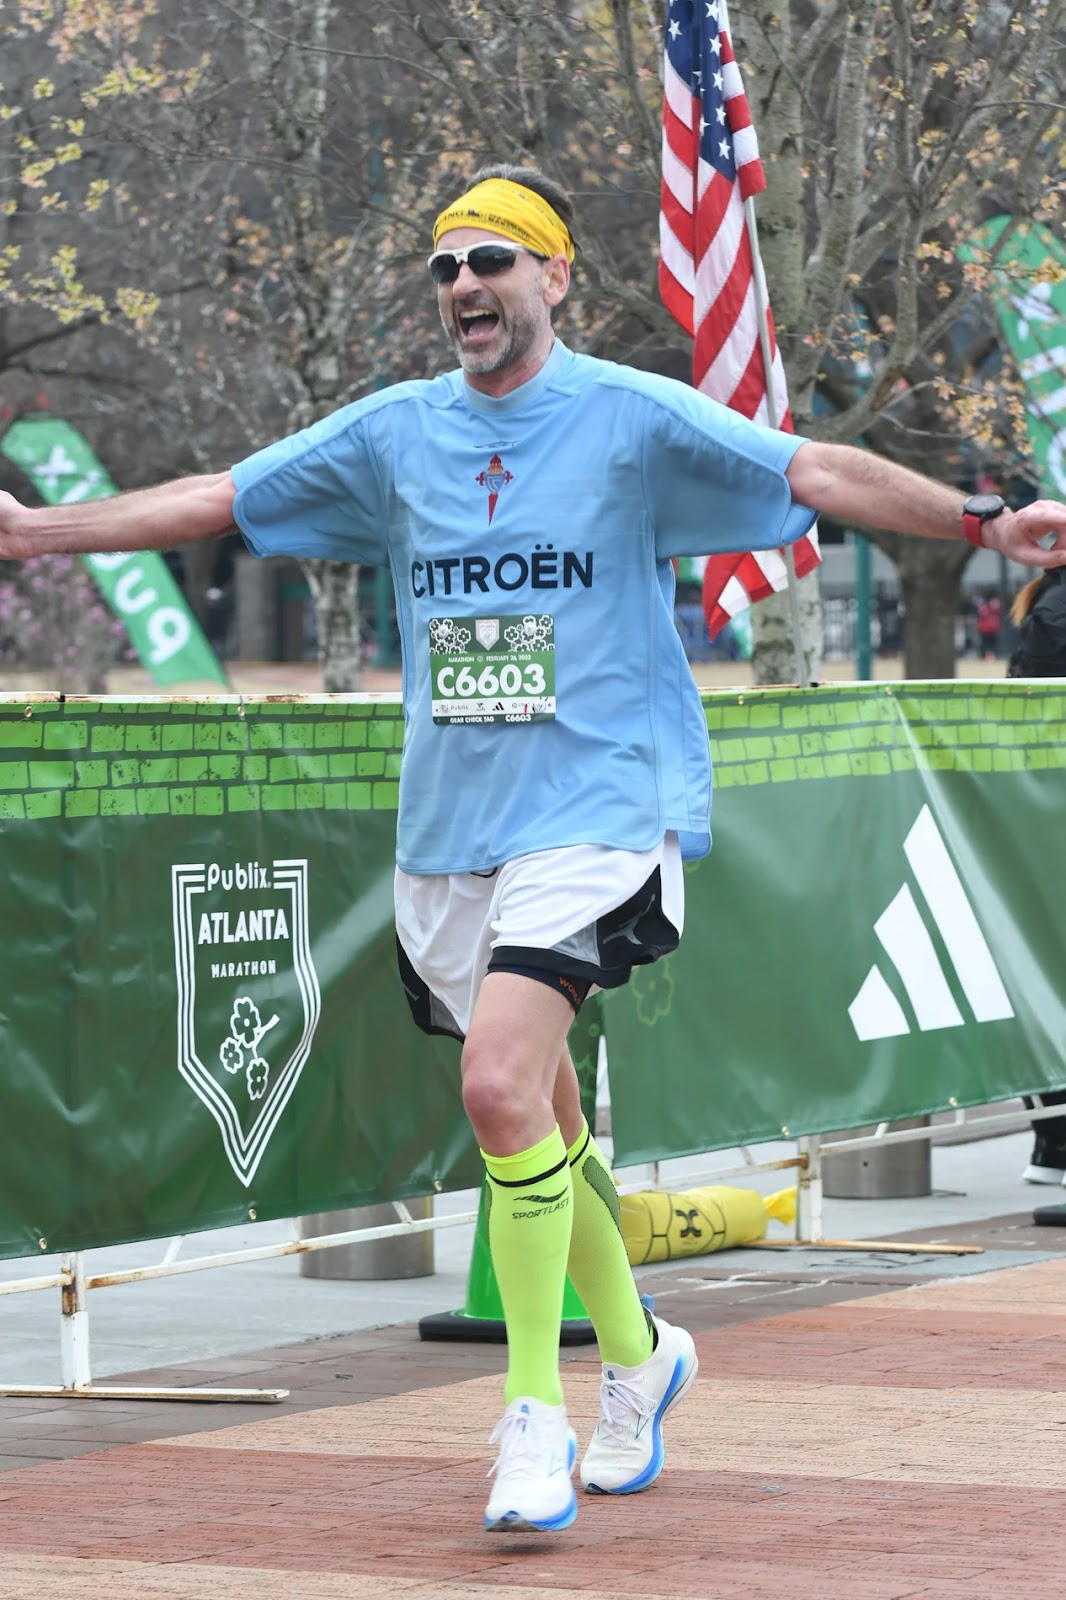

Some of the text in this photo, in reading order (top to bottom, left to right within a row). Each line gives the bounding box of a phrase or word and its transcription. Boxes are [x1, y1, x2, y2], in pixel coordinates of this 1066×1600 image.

[411, 543, 593, 598] CITROËN
[437, 663, 546, 697] C6603
[450, 716, 464, 724] GEAR
[483, 715, 495, 723] TAG
[505, 714, 532, 723] C6603
[198, 908, 290, 945] ATLANTA
[211, 959, 276, 979] MARATHON
[511, 1197, 569, 1220] SPORTLAST
